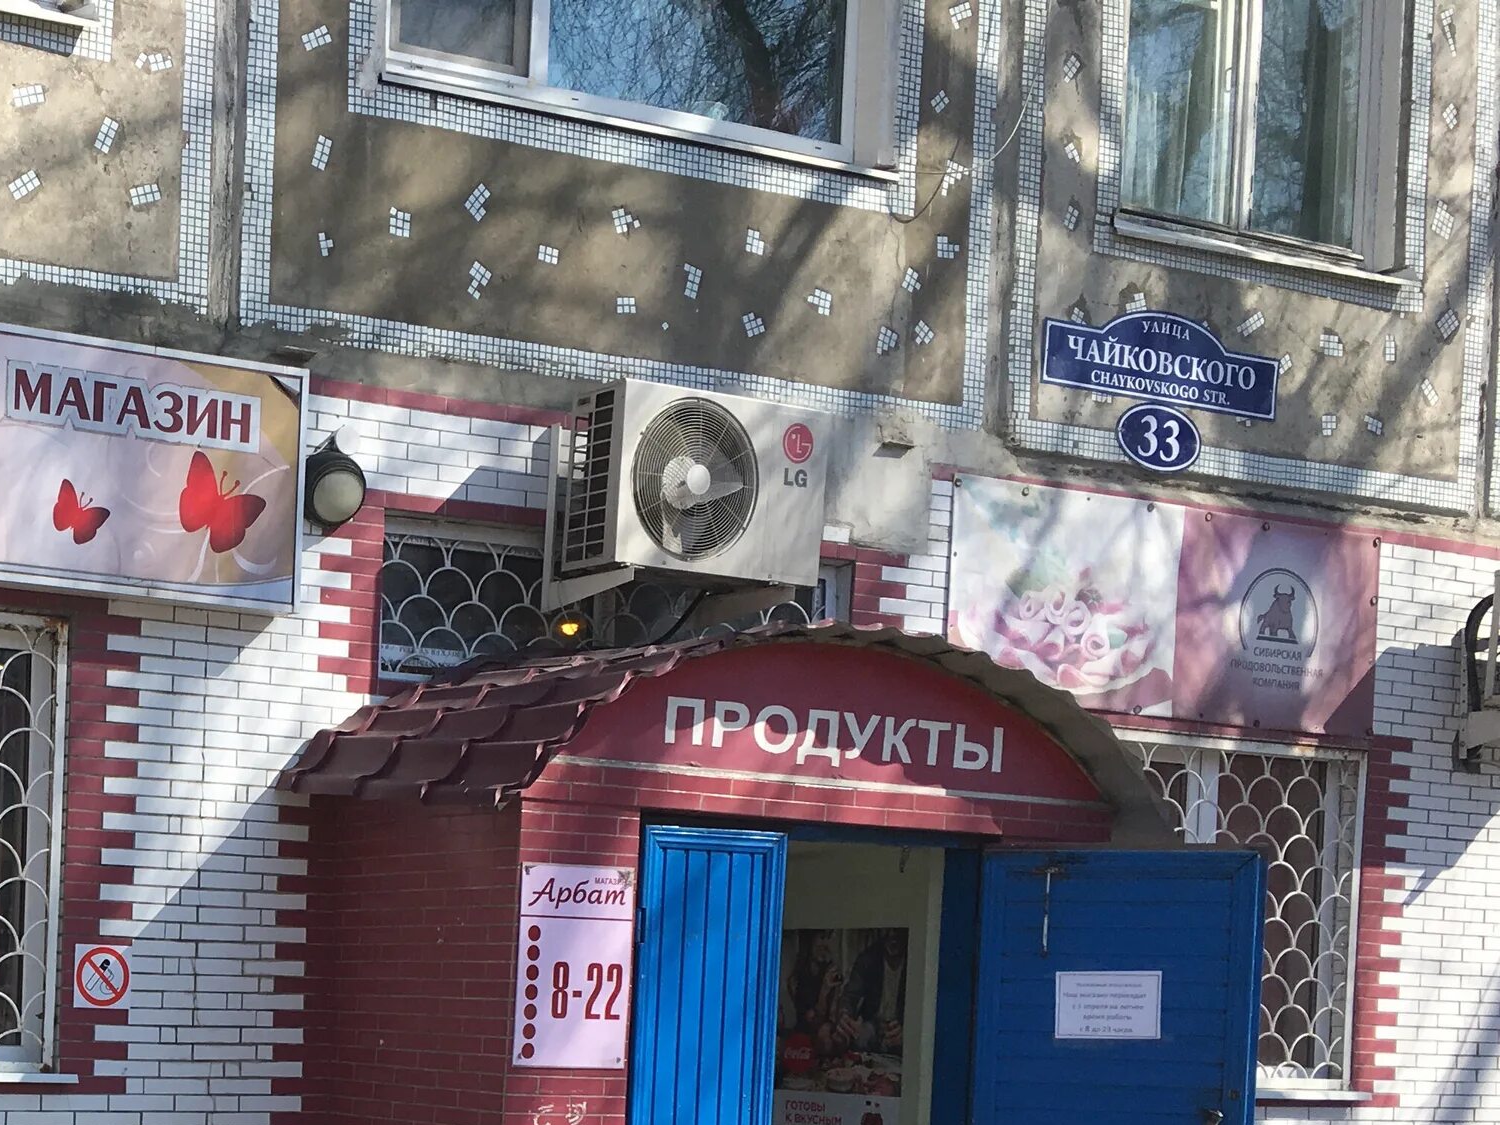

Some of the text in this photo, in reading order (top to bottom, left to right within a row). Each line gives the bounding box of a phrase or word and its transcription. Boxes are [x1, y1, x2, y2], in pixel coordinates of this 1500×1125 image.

[1141, 320, 1191, 341] УЛИЦА
[1067, 335, 1256, 390] ЧАЙКОВСКОГО
[1091, 369, 1230, 405] CHAYKOVSKOGO STR.
[13, 366, 253, 445] МАГАЗИН
[1137, 415, 1181, 462] 33
[783, 467, 808, 488] LG
[1230, 658, 1323, 678] ПРОДОВОЛЬСТВЕННАЯ
[1253, 646, 1302, 661] СИБИРСКАЯ
[665, 696, 1004, 773] ПРОДУКТЫ
[528, 877, 626, 909] Арбат
[551, 961, 623, 1020] 8-22
[785, 1100, 826, 1112] ГОТОВЫ
[785, 1114, 793, 1124] К
